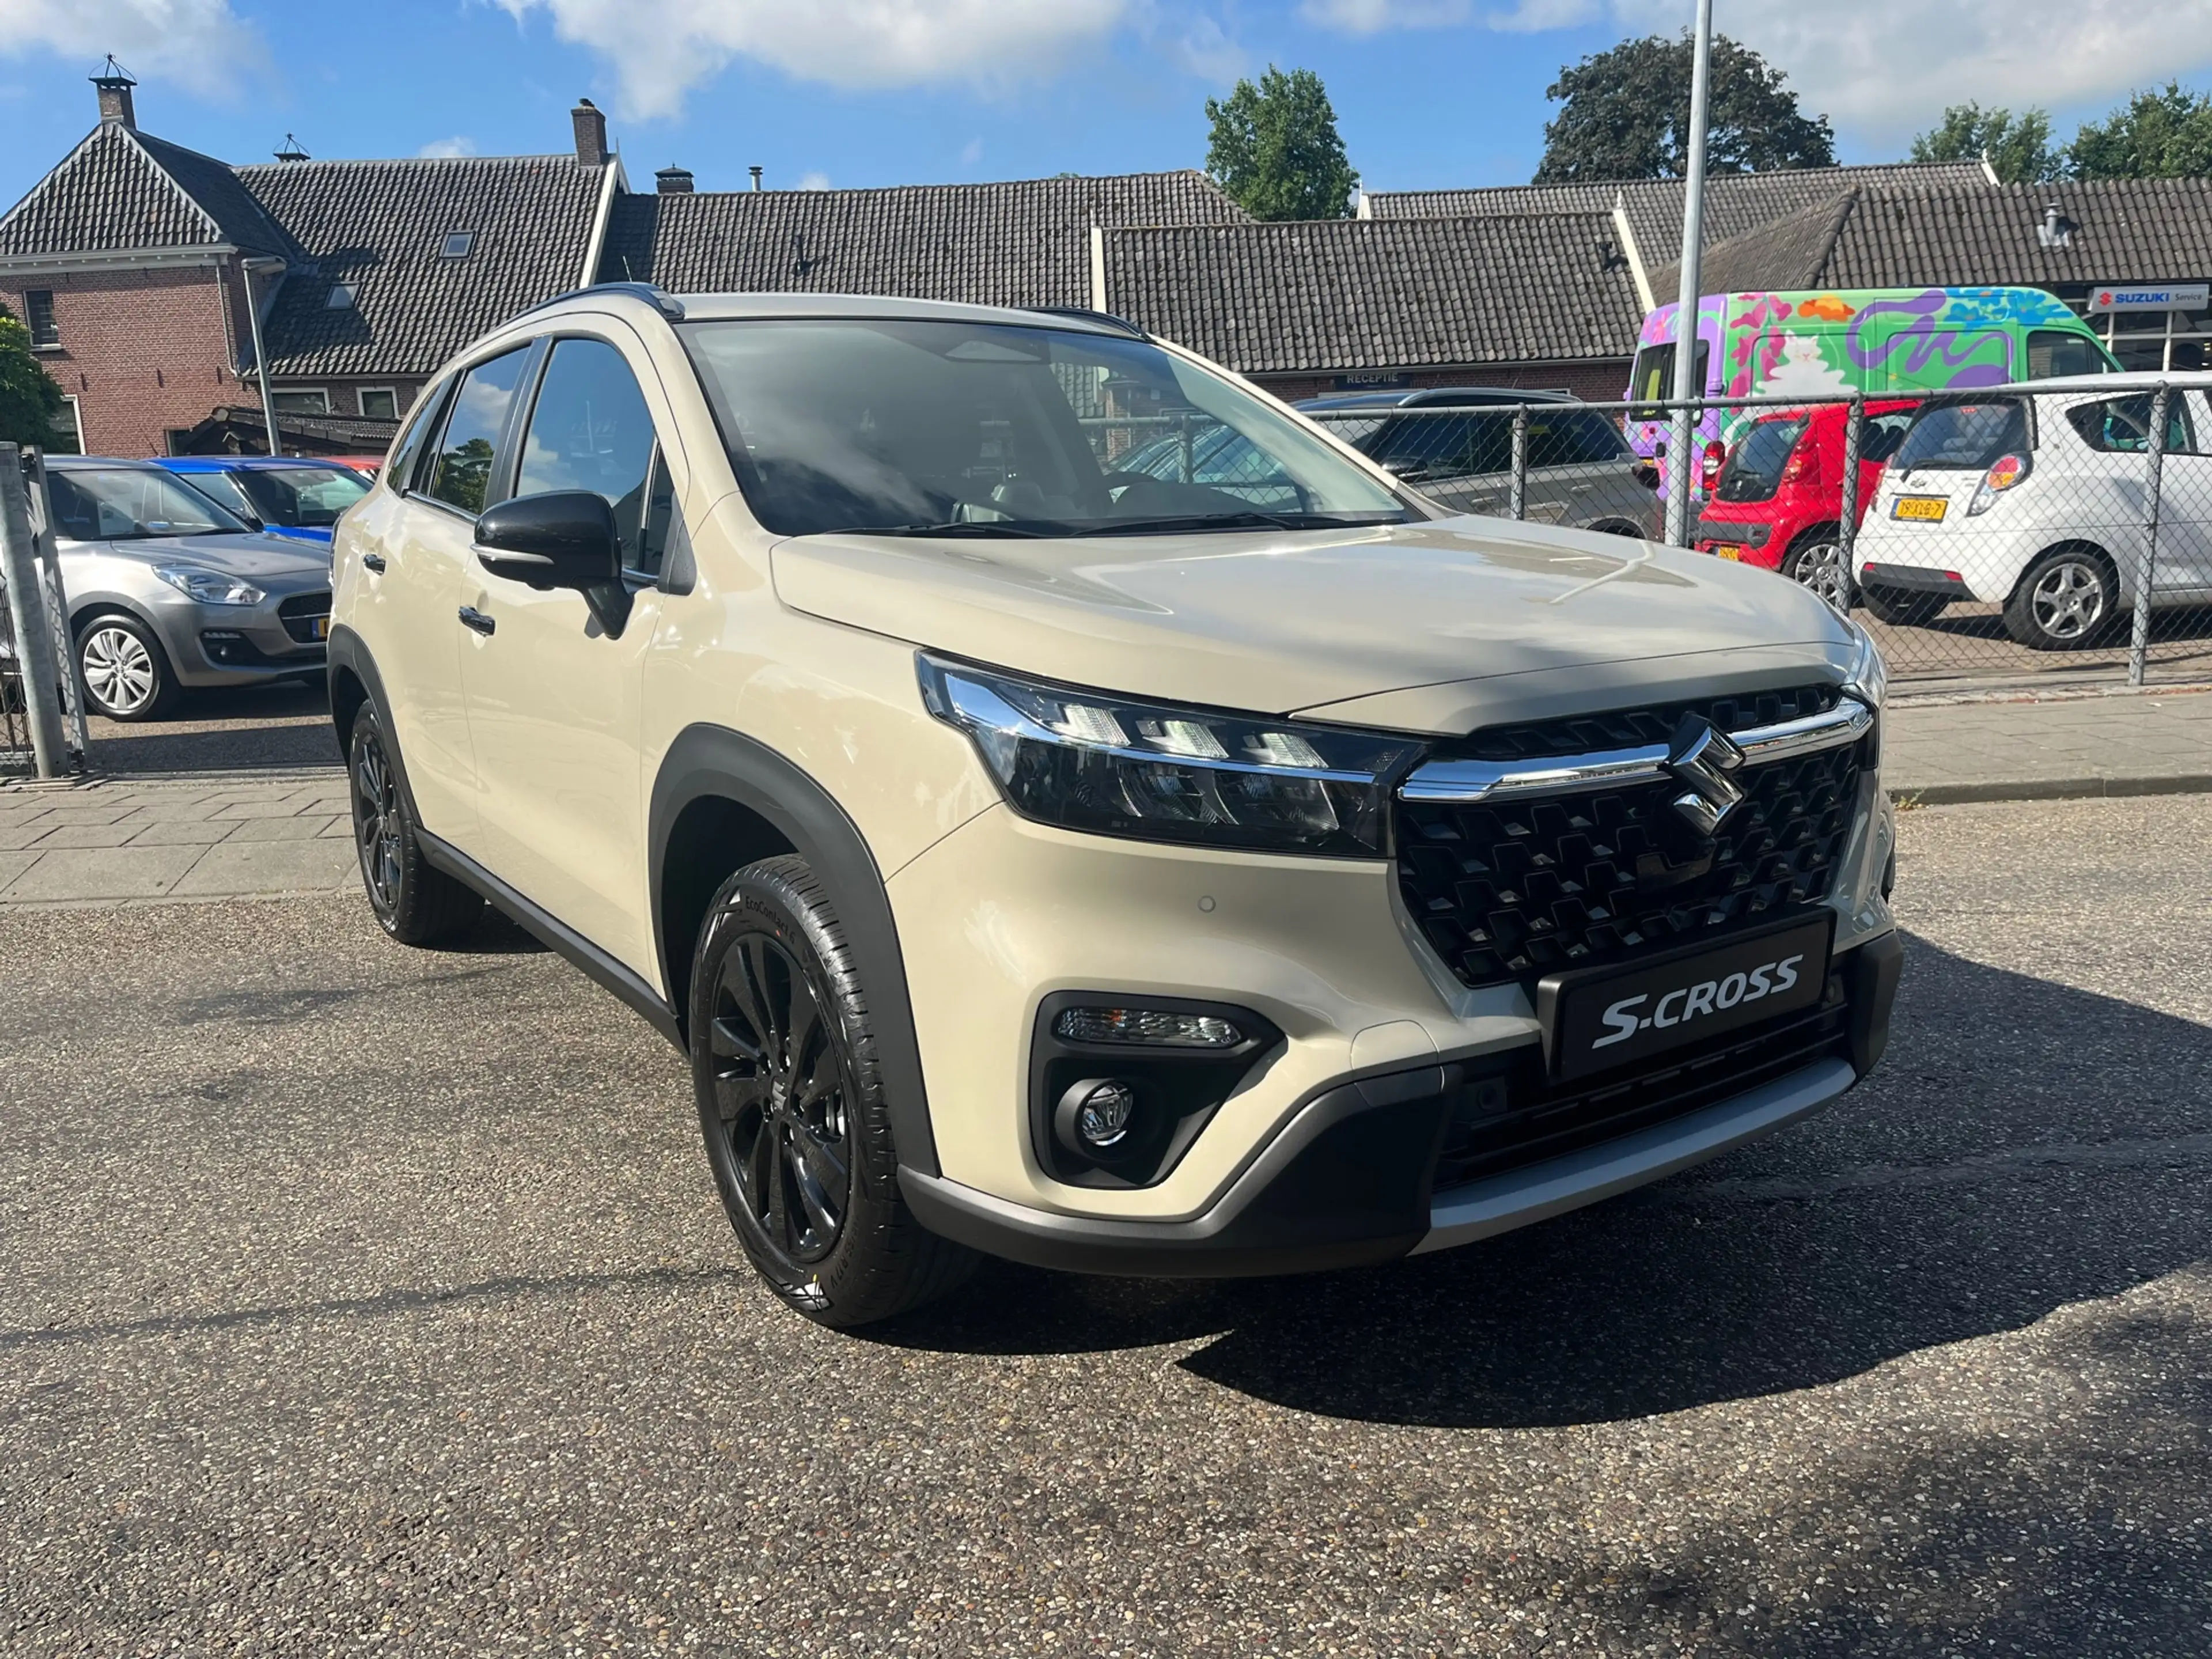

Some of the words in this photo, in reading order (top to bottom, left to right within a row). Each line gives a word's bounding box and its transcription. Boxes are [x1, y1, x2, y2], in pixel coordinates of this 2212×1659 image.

[2115, 293, 2170, 304] SUZUKI
[2175, 293, 2202, 301] Service
[1346, 373, 1399, 384] RECEPTIE
[745, 895, 789, 936] EcoContact
[789, 931, 796, 945] 6
[1592, 954, 1804, 1049] S-CROSS
